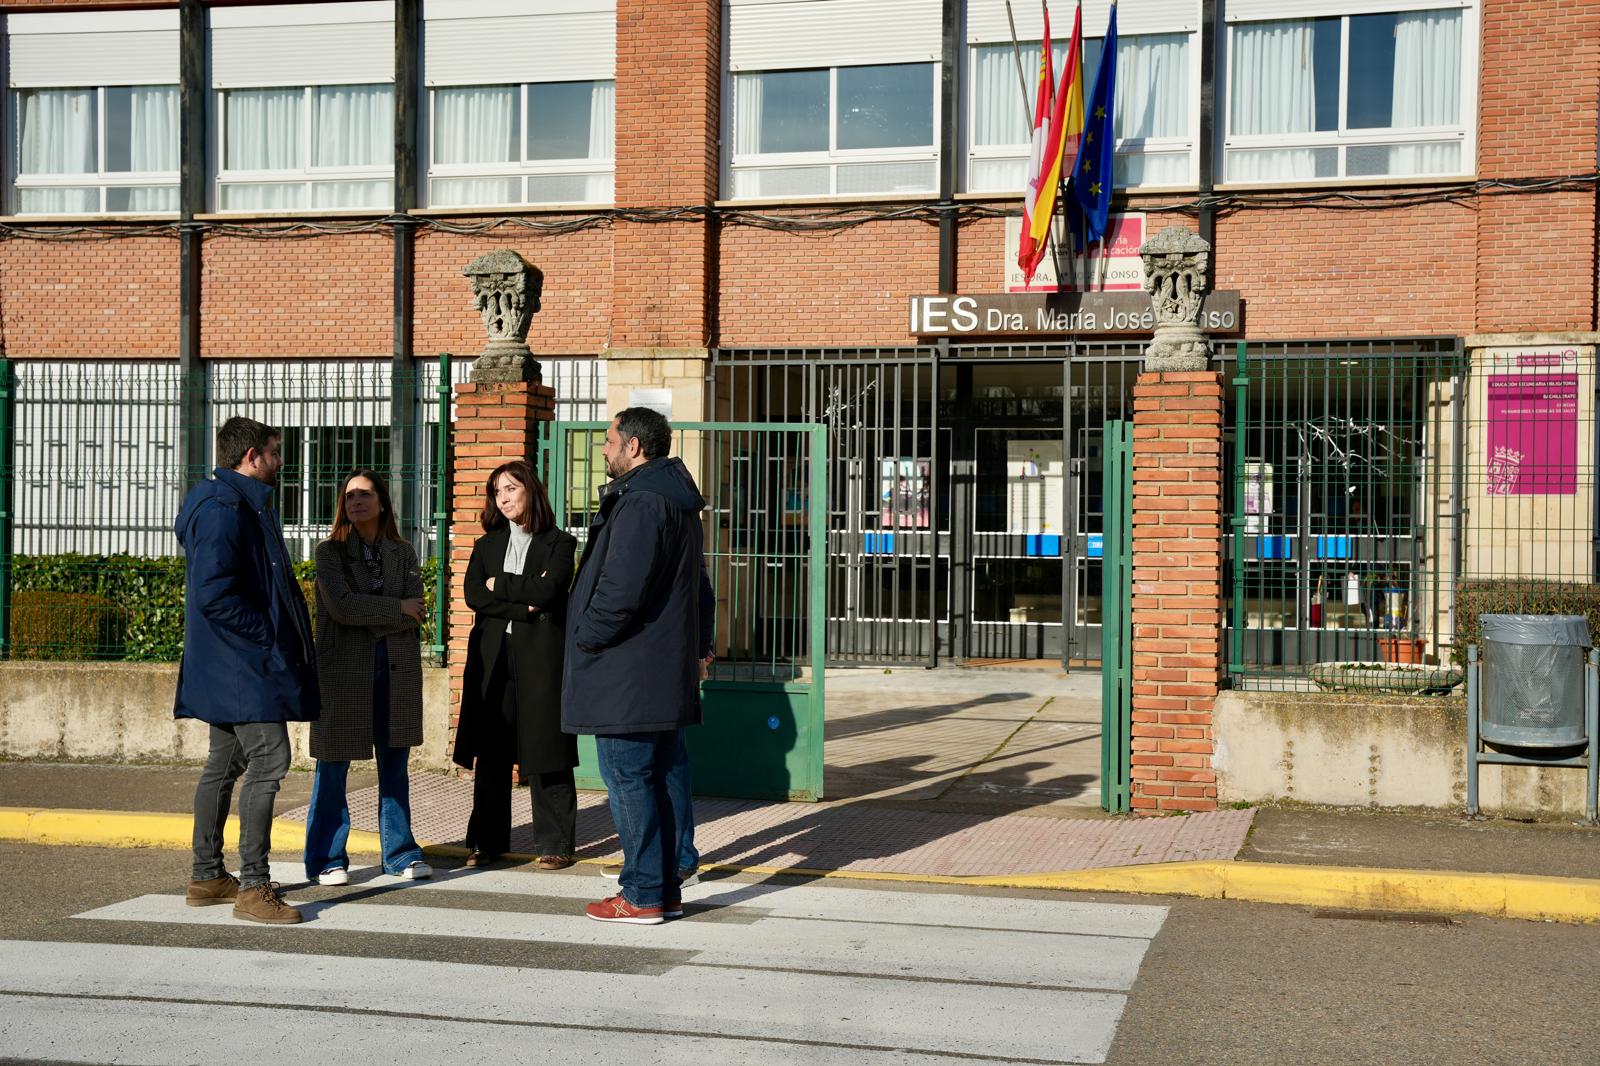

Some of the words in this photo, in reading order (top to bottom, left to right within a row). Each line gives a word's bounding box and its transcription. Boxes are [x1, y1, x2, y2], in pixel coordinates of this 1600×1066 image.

[1102, 270, 1139, 280] LONSO
[910, 296, 978, 332] IES
[986, 308, 1029, 331] Dra.
[1036, 307, 1096, 331] María
[1103, 306, 1154, 330] José
